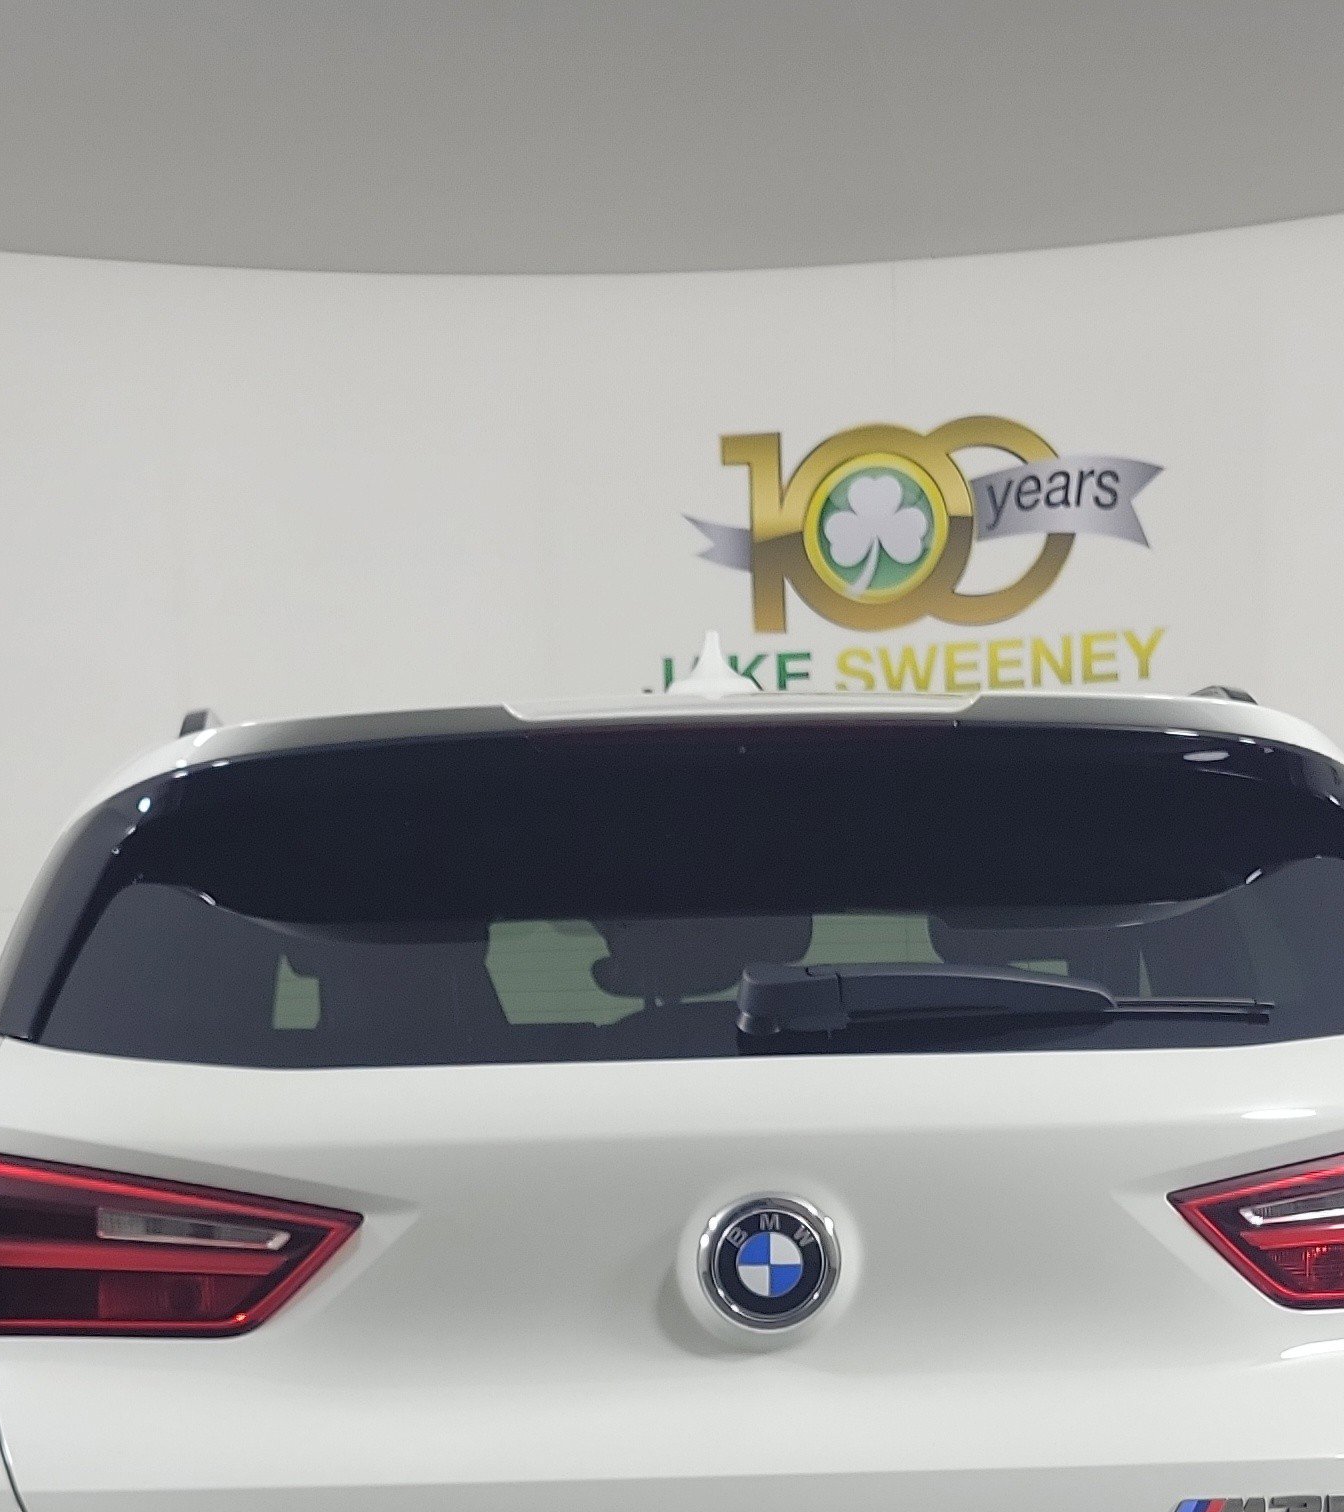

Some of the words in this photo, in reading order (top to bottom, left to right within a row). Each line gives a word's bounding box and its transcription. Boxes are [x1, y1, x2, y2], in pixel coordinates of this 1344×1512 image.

[987, 467, 1121, 529] years
[640, 652, 812, 692] JKE
[835, 628, 1165, 692] SWEENEY
[726, 1213, 815, 1248] BMW
